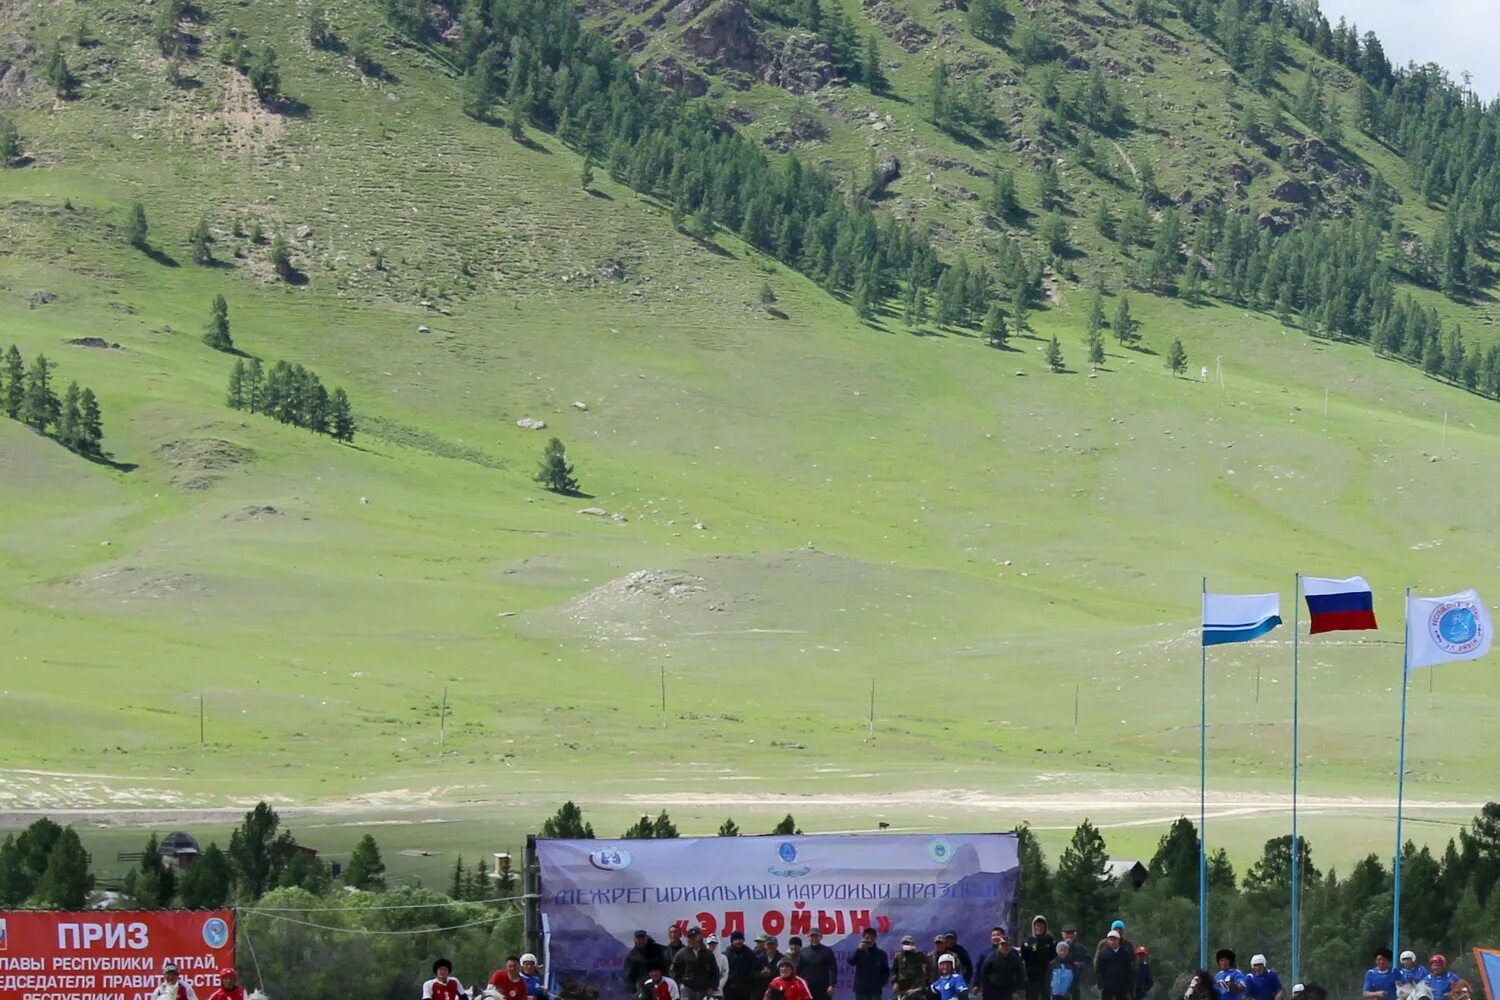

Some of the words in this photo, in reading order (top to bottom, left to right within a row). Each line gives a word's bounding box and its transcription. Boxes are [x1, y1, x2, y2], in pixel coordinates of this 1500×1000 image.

[555, 884, 780, 905] МЕЖРЕГИОНАЛЬНЫЙ
[788, 883, 890, 899] НАРОДНЫЙ
[899, 882, 1003, 898] ПРАЗД
[762, 902, 891, 936] ОЙЫН»
[58, 922, 149, 949] ПРИЗ
[53, 957, 153, 971] РЕСПУБЛИКИ
[162, 953, 218, 970] АЛТАЙ,
[0, 975, 95, 991] ЕДСЕДАТЕЛЯ
[103, 974, 221, 989] ПРАВИТЬСТВ
